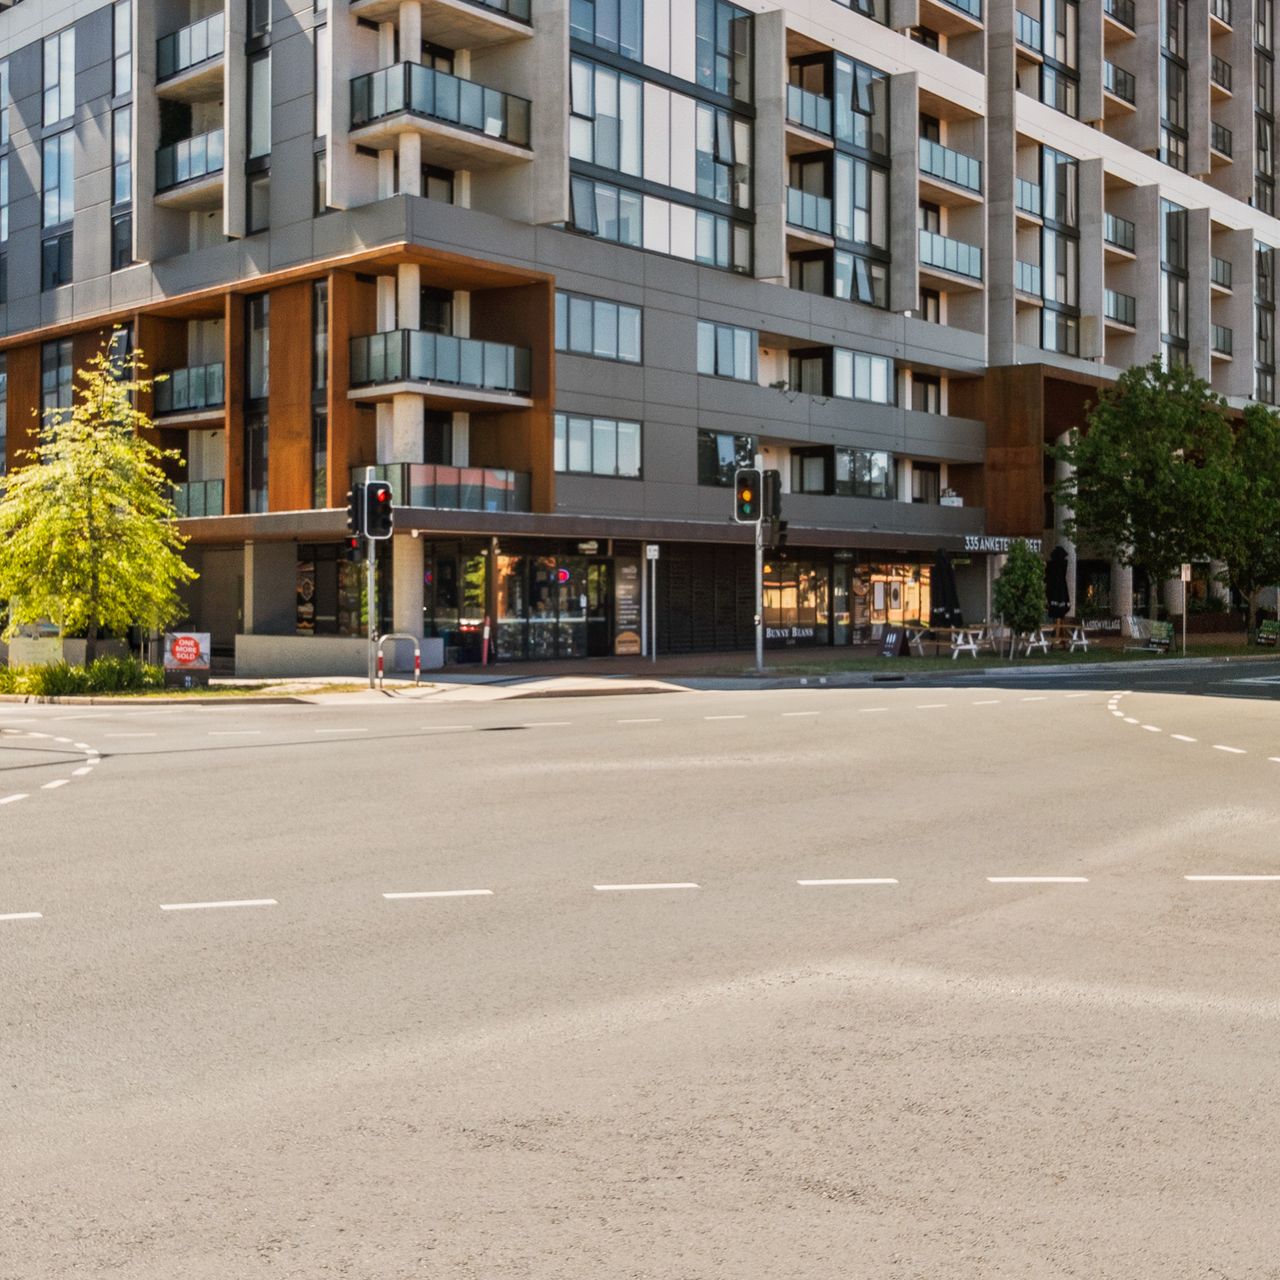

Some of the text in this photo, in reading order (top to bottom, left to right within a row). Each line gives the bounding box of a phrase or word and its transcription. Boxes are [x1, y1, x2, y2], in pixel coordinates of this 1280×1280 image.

[964, 535, 979, 550] 335
[979, 537, 1017, 552] ANKETE
[766, 626, 814, 638] BUNNY BEANS
